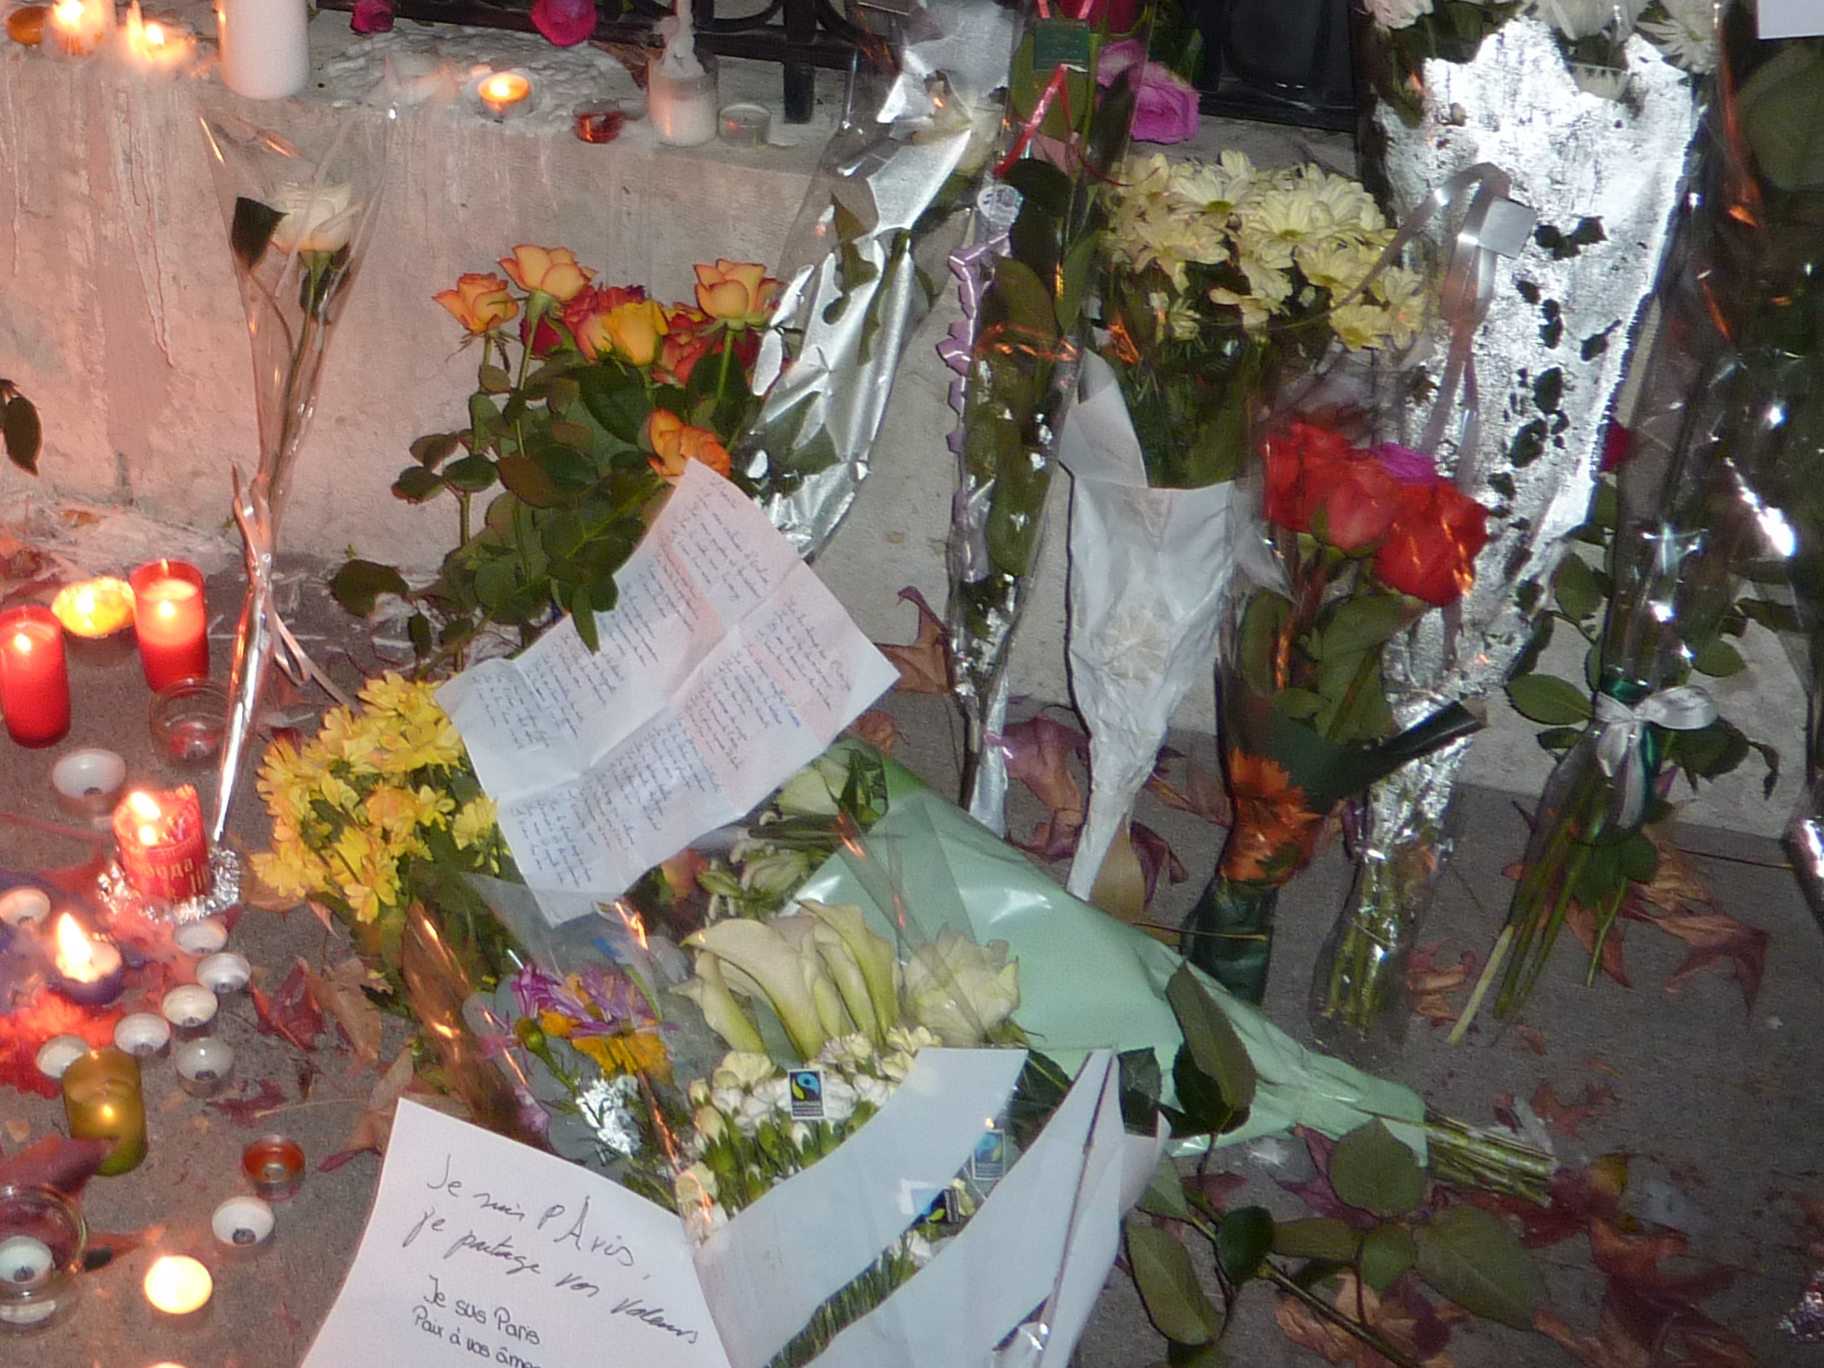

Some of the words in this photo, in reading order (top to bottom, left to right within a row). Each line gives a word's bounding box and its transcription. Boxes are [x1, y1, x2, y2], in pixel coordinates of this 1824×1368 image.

[426, 1154, 462, 1197] Je
[411, 1304, 445, 1338] Paix
[449, 1326, 462, 1346] à
[423, 1274, 447, 1308] Je
[493, 1306, 541, 1345] Paris
